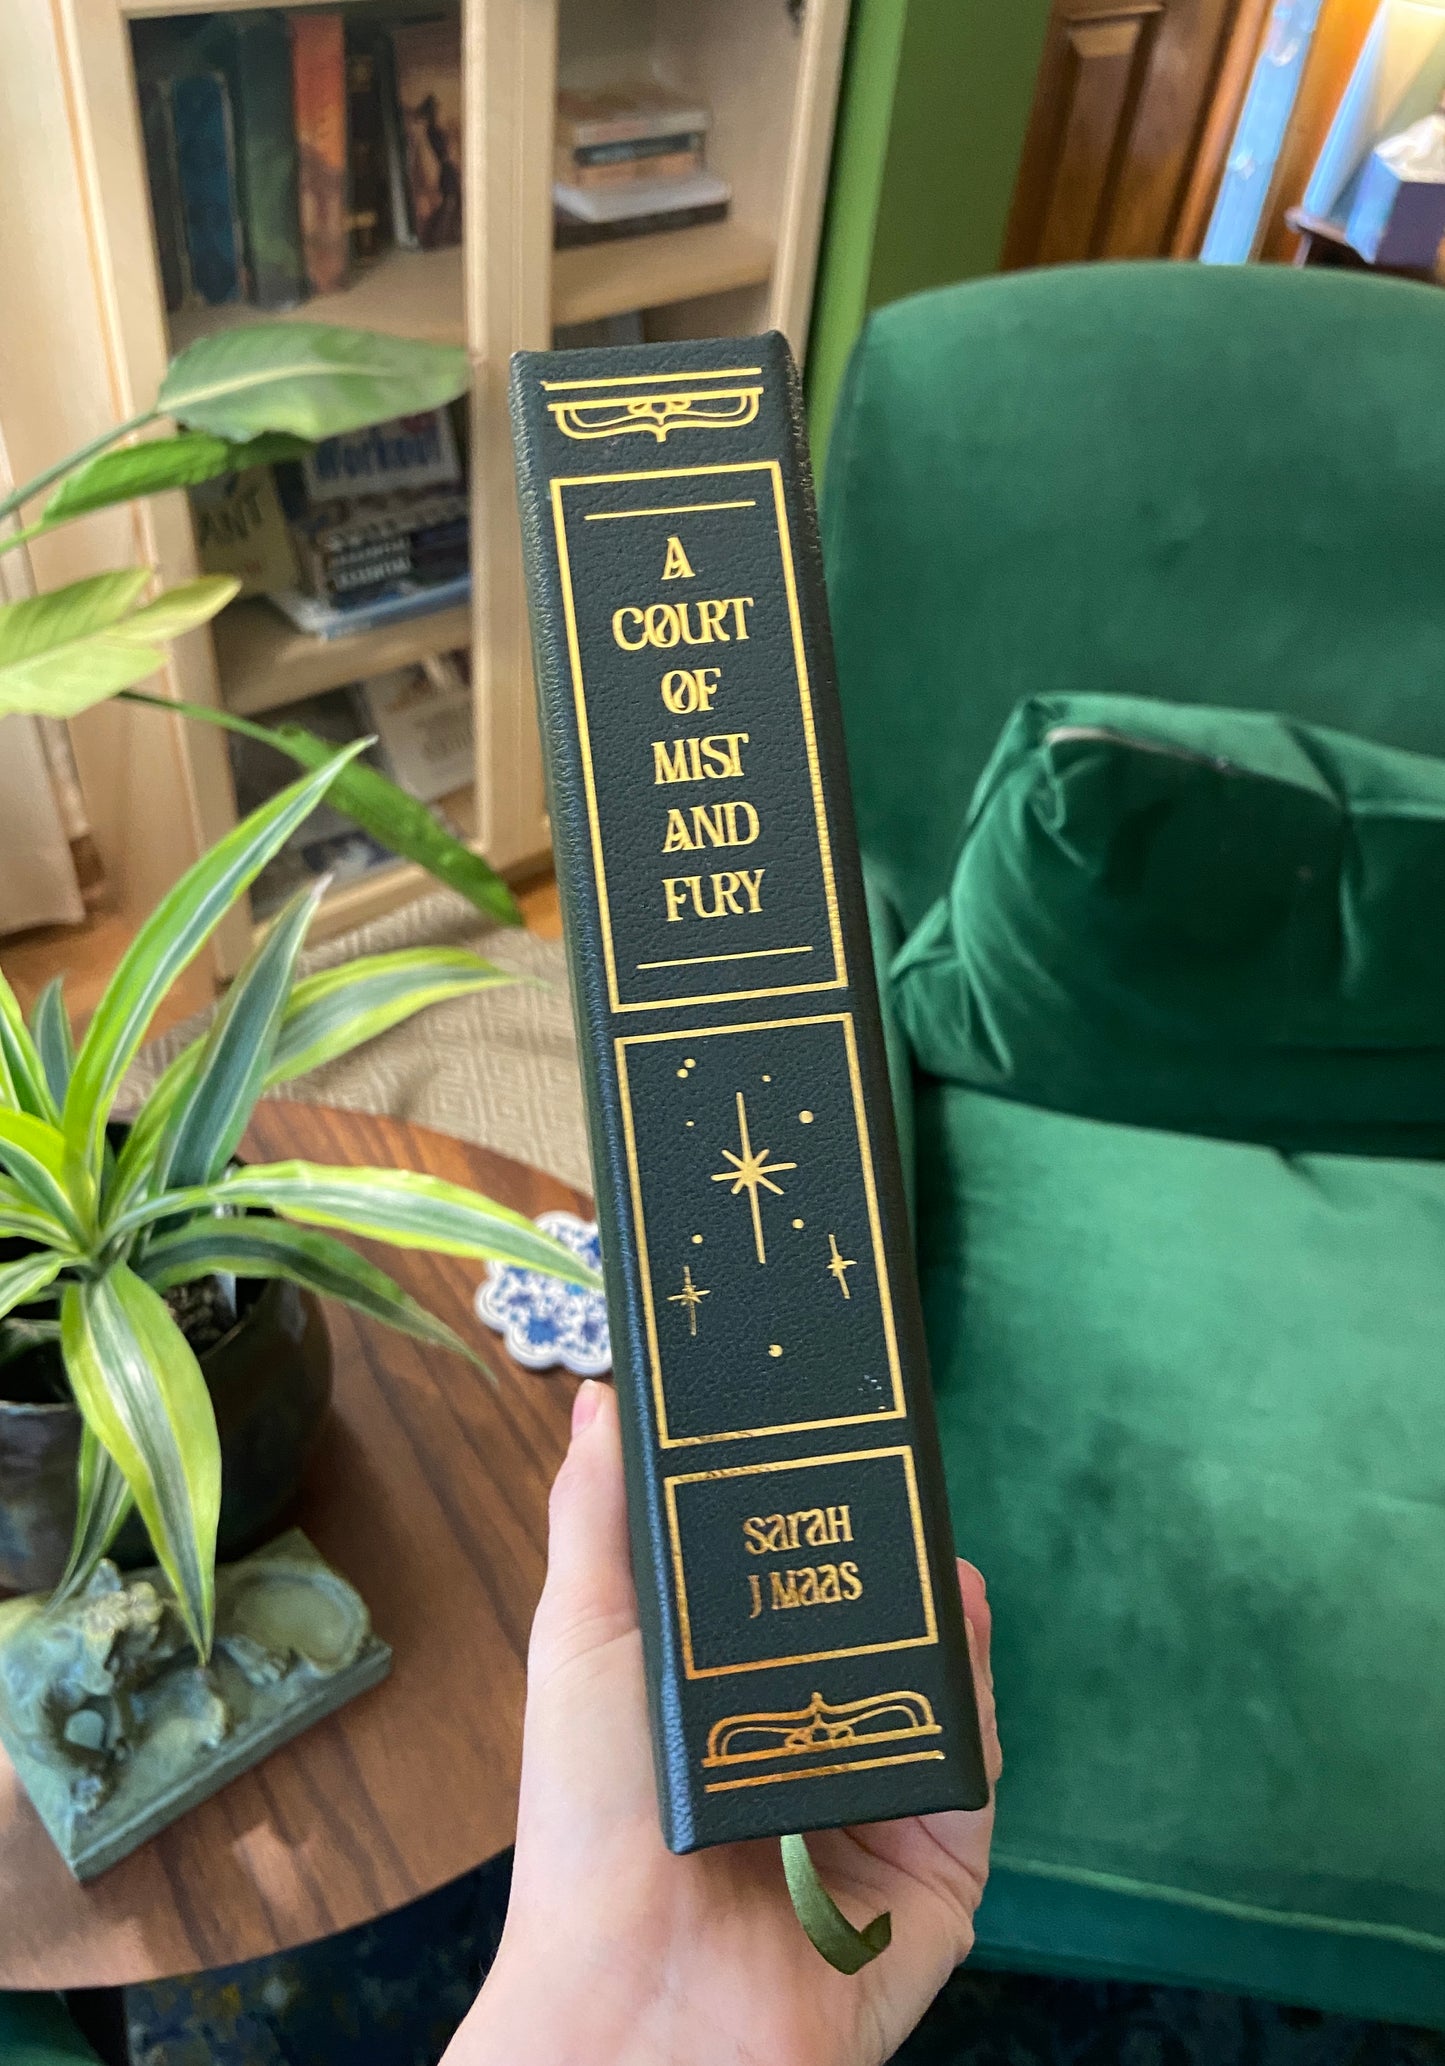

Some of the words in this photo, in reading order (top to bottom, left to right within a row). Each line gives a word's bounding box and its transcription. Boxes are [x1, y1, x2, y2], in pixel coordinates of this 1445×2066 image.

[661, 535, 695, 581] A
[611, 597, 755, 652] COURT
[660, 667, 722, 715] OF
[652, 732, 750, 785] MIST
[662, 801, 760, 852] AND
[662, 870, 765, 922] FURY
